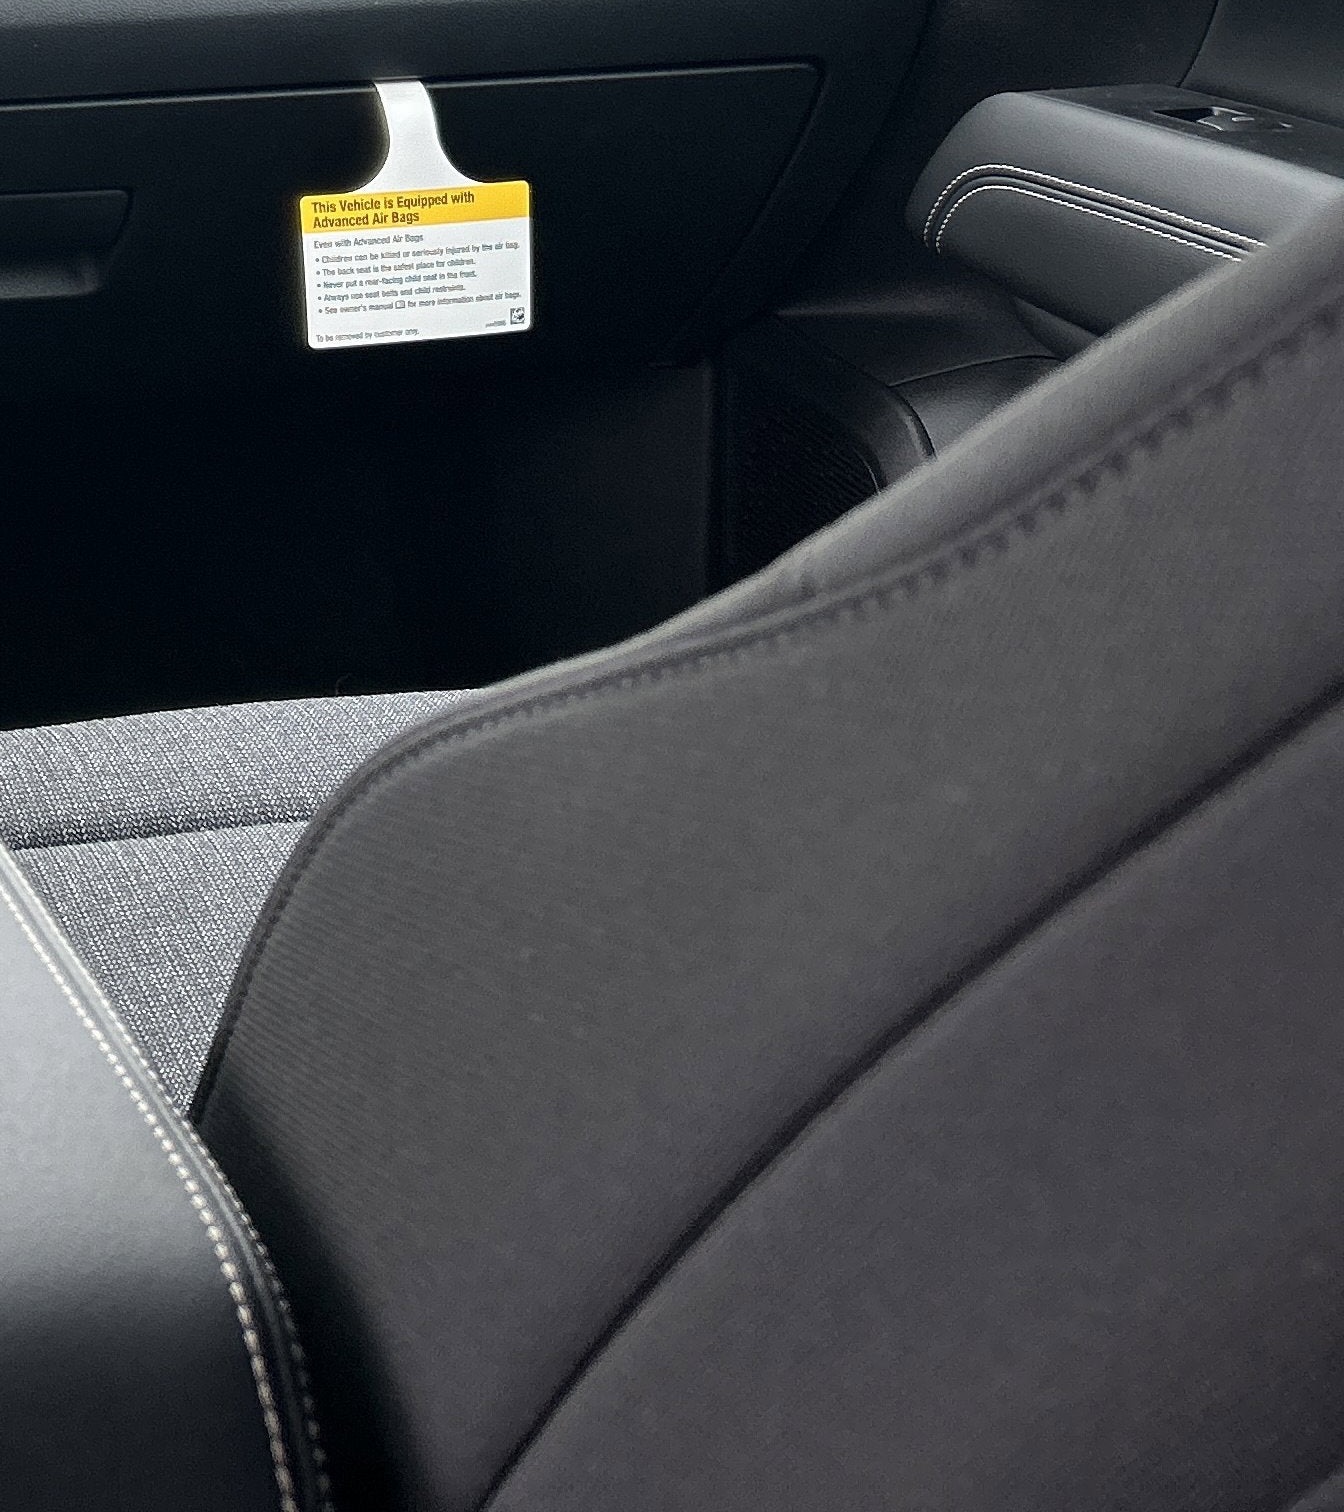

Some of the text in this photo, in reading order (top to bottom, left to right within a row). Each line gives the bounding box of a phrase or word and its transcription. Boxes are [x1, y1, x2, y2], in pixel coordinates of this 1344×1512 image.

[312, 192, 475, 213] This Vehicle is Equipped with
[313, 211, 419, 228] Advanced Air Bags
